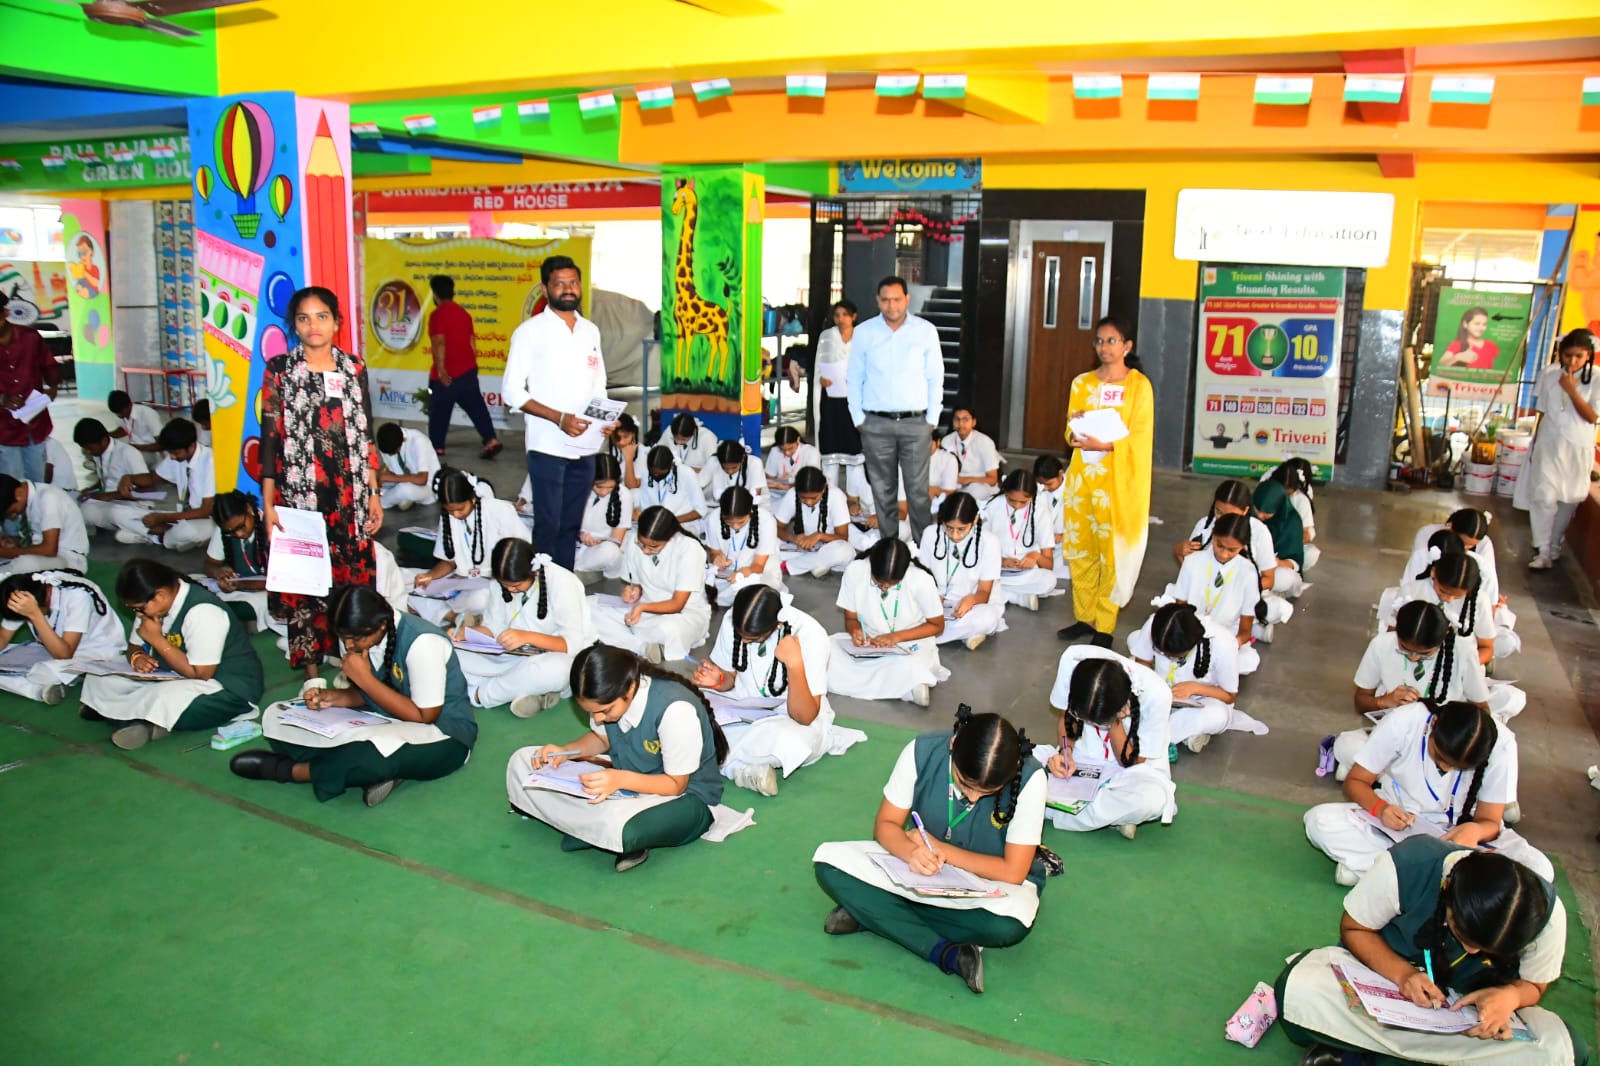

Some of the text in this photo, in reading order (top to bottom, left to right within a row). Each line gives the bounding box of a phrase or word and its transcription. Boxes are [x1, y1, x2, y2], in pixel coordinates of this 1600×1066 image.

[860, 158, 957, 178] Welcome
[473, 193, 569, 209] RED HOUSE
[1232, 271, 1326, 284] Triveni Shining with
[1236, 284, 1278, 296] Stunning
[1209, 325, 1245, 357] 71
[1272, 426, 1327, 446] Triveni
